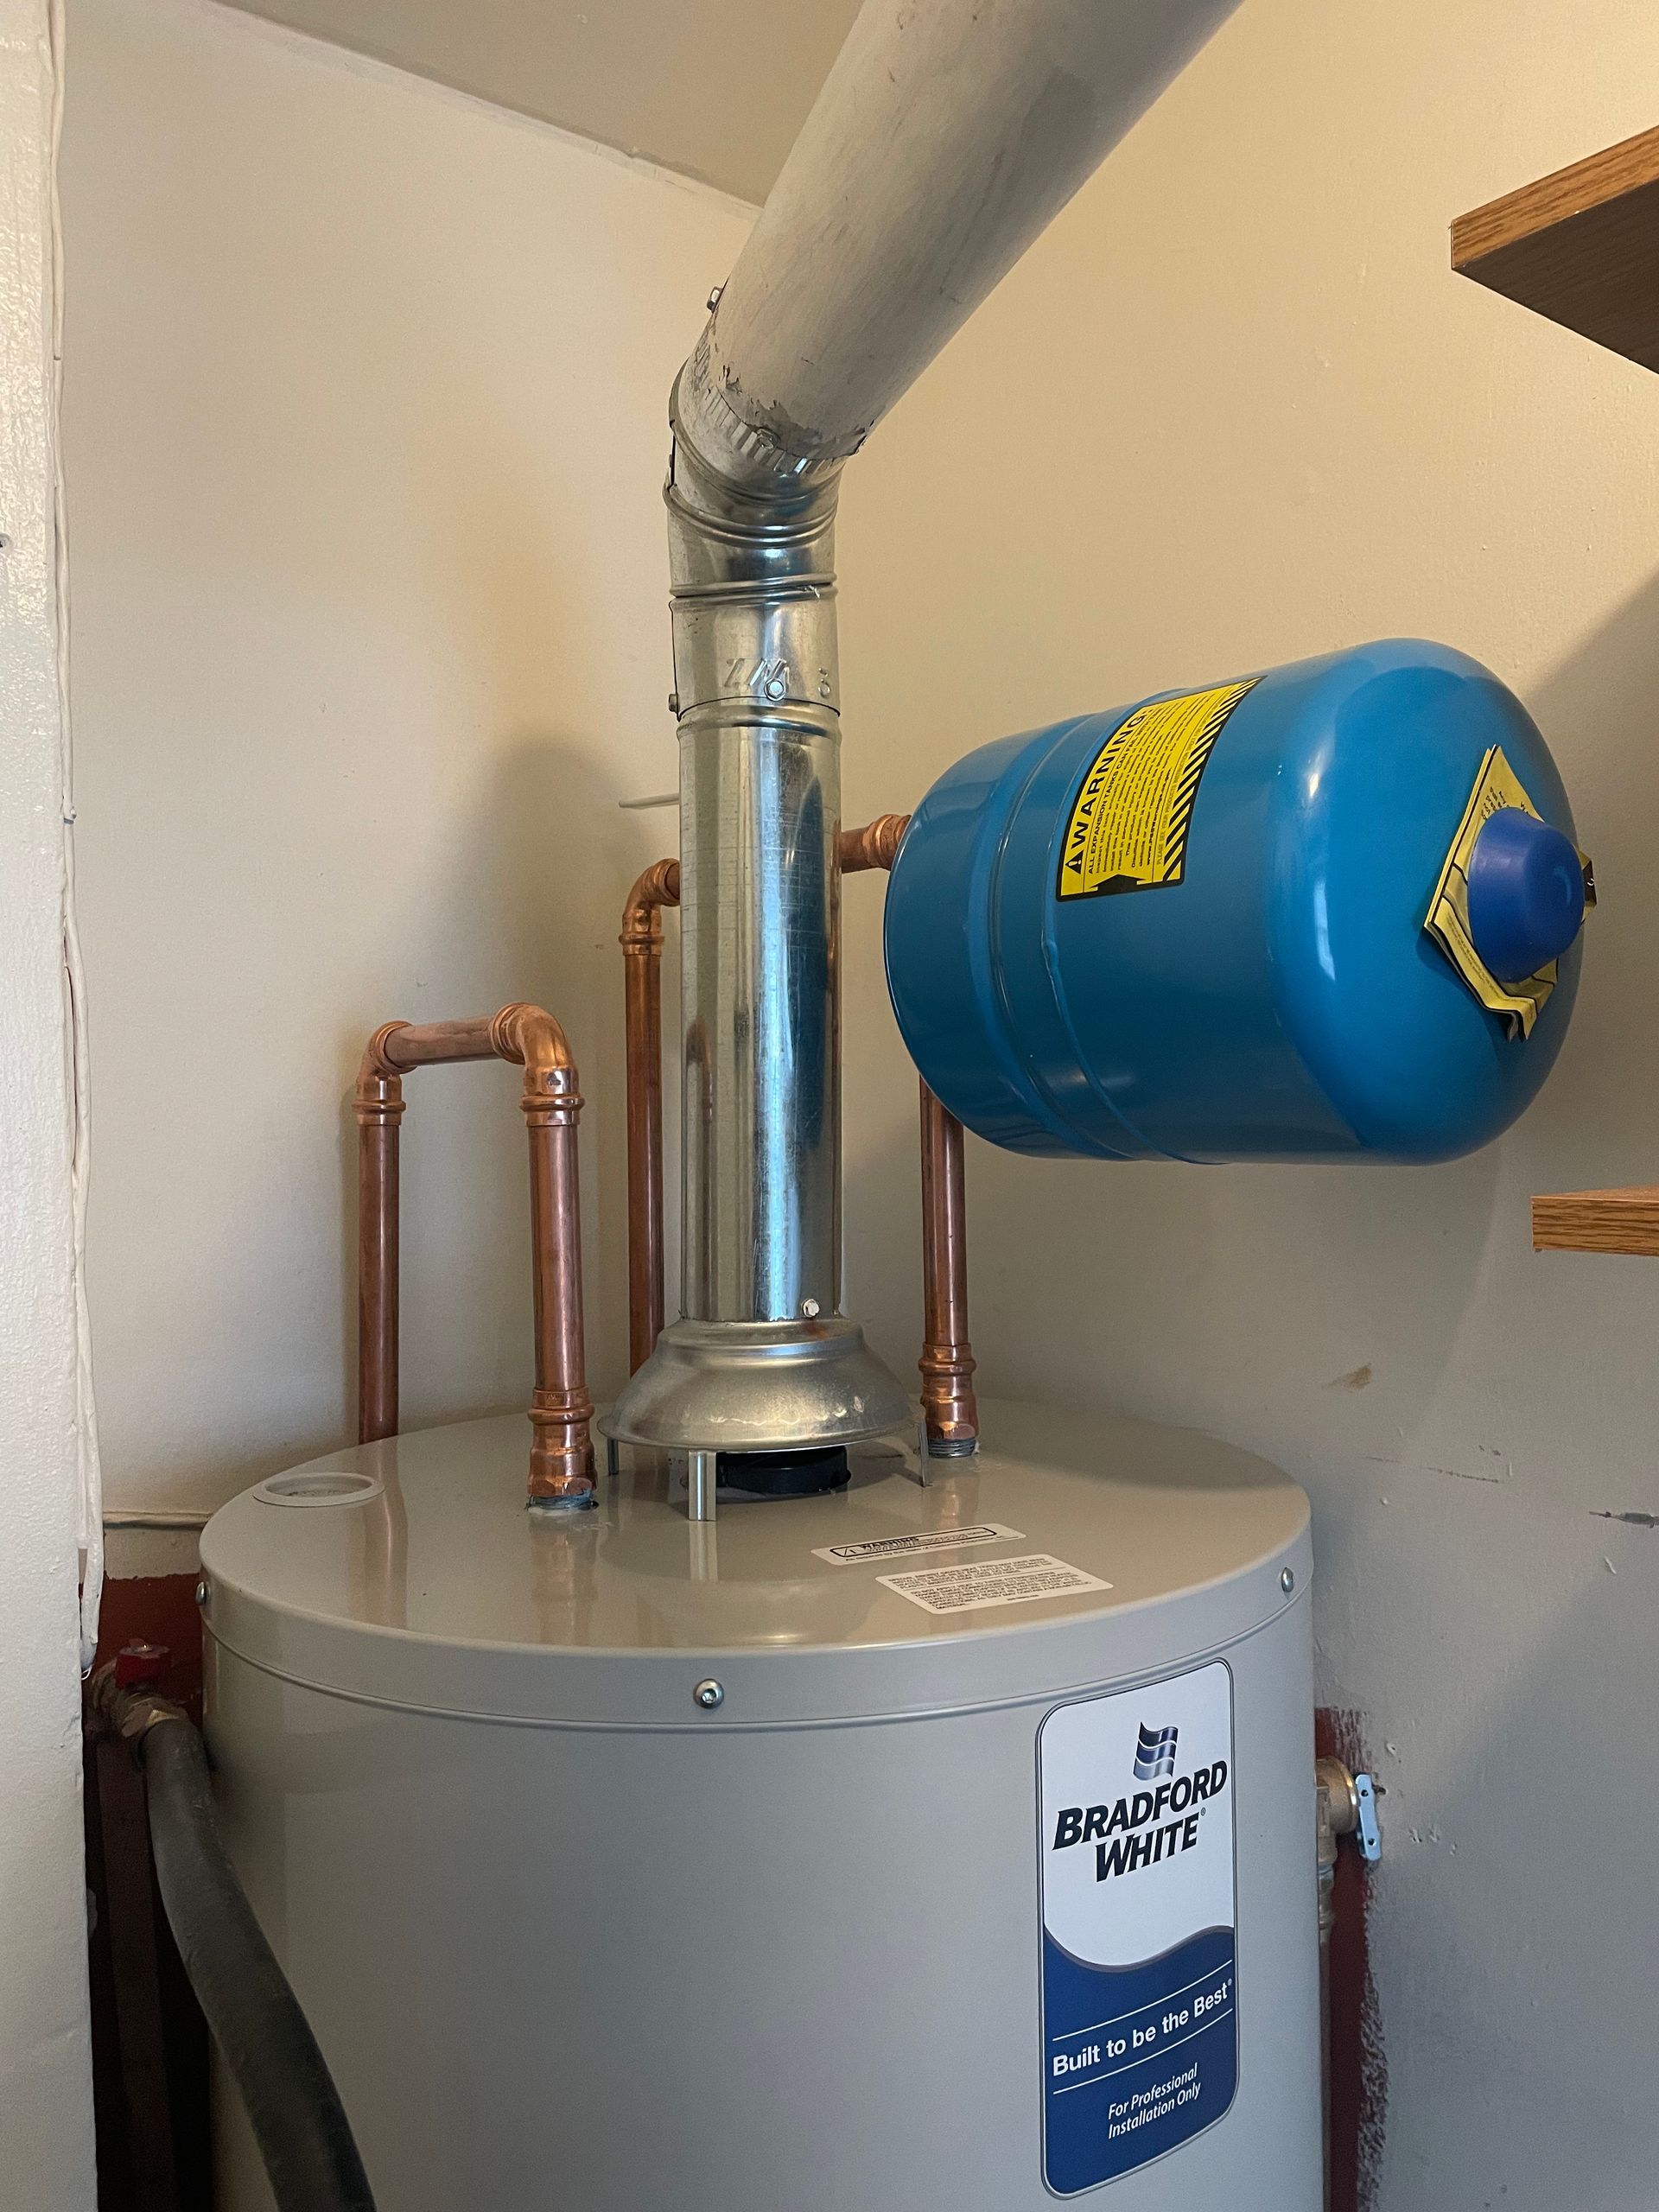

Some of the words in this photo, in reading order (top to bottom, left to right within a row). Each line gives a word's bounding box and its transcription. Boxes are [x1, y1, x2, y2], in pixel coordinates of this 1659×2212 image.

[1071, 709, 1154, 849] WARNING:
[1090, 800, 1108, 854] EXPANSION
[1103, 770, 1119, 798] TANKS
[1116, 753, 1128, 769] CAN
[1052, 1760, 1228, 1851] BRADFORD
[1053, 2045, 1100, 2076] Built
[1106, 2038, 1126, 2058] to
[1133, 2026, 1156, 2049] be
[1162, 2010, 1188, 2035] the
[1108, 2101, 1128, 2120] For
[1131, 2063, 1198, 2111] Professional
[1108, 2098, 1174, 2139] Installation
[1177, 2082, 1201, 2106] Only
